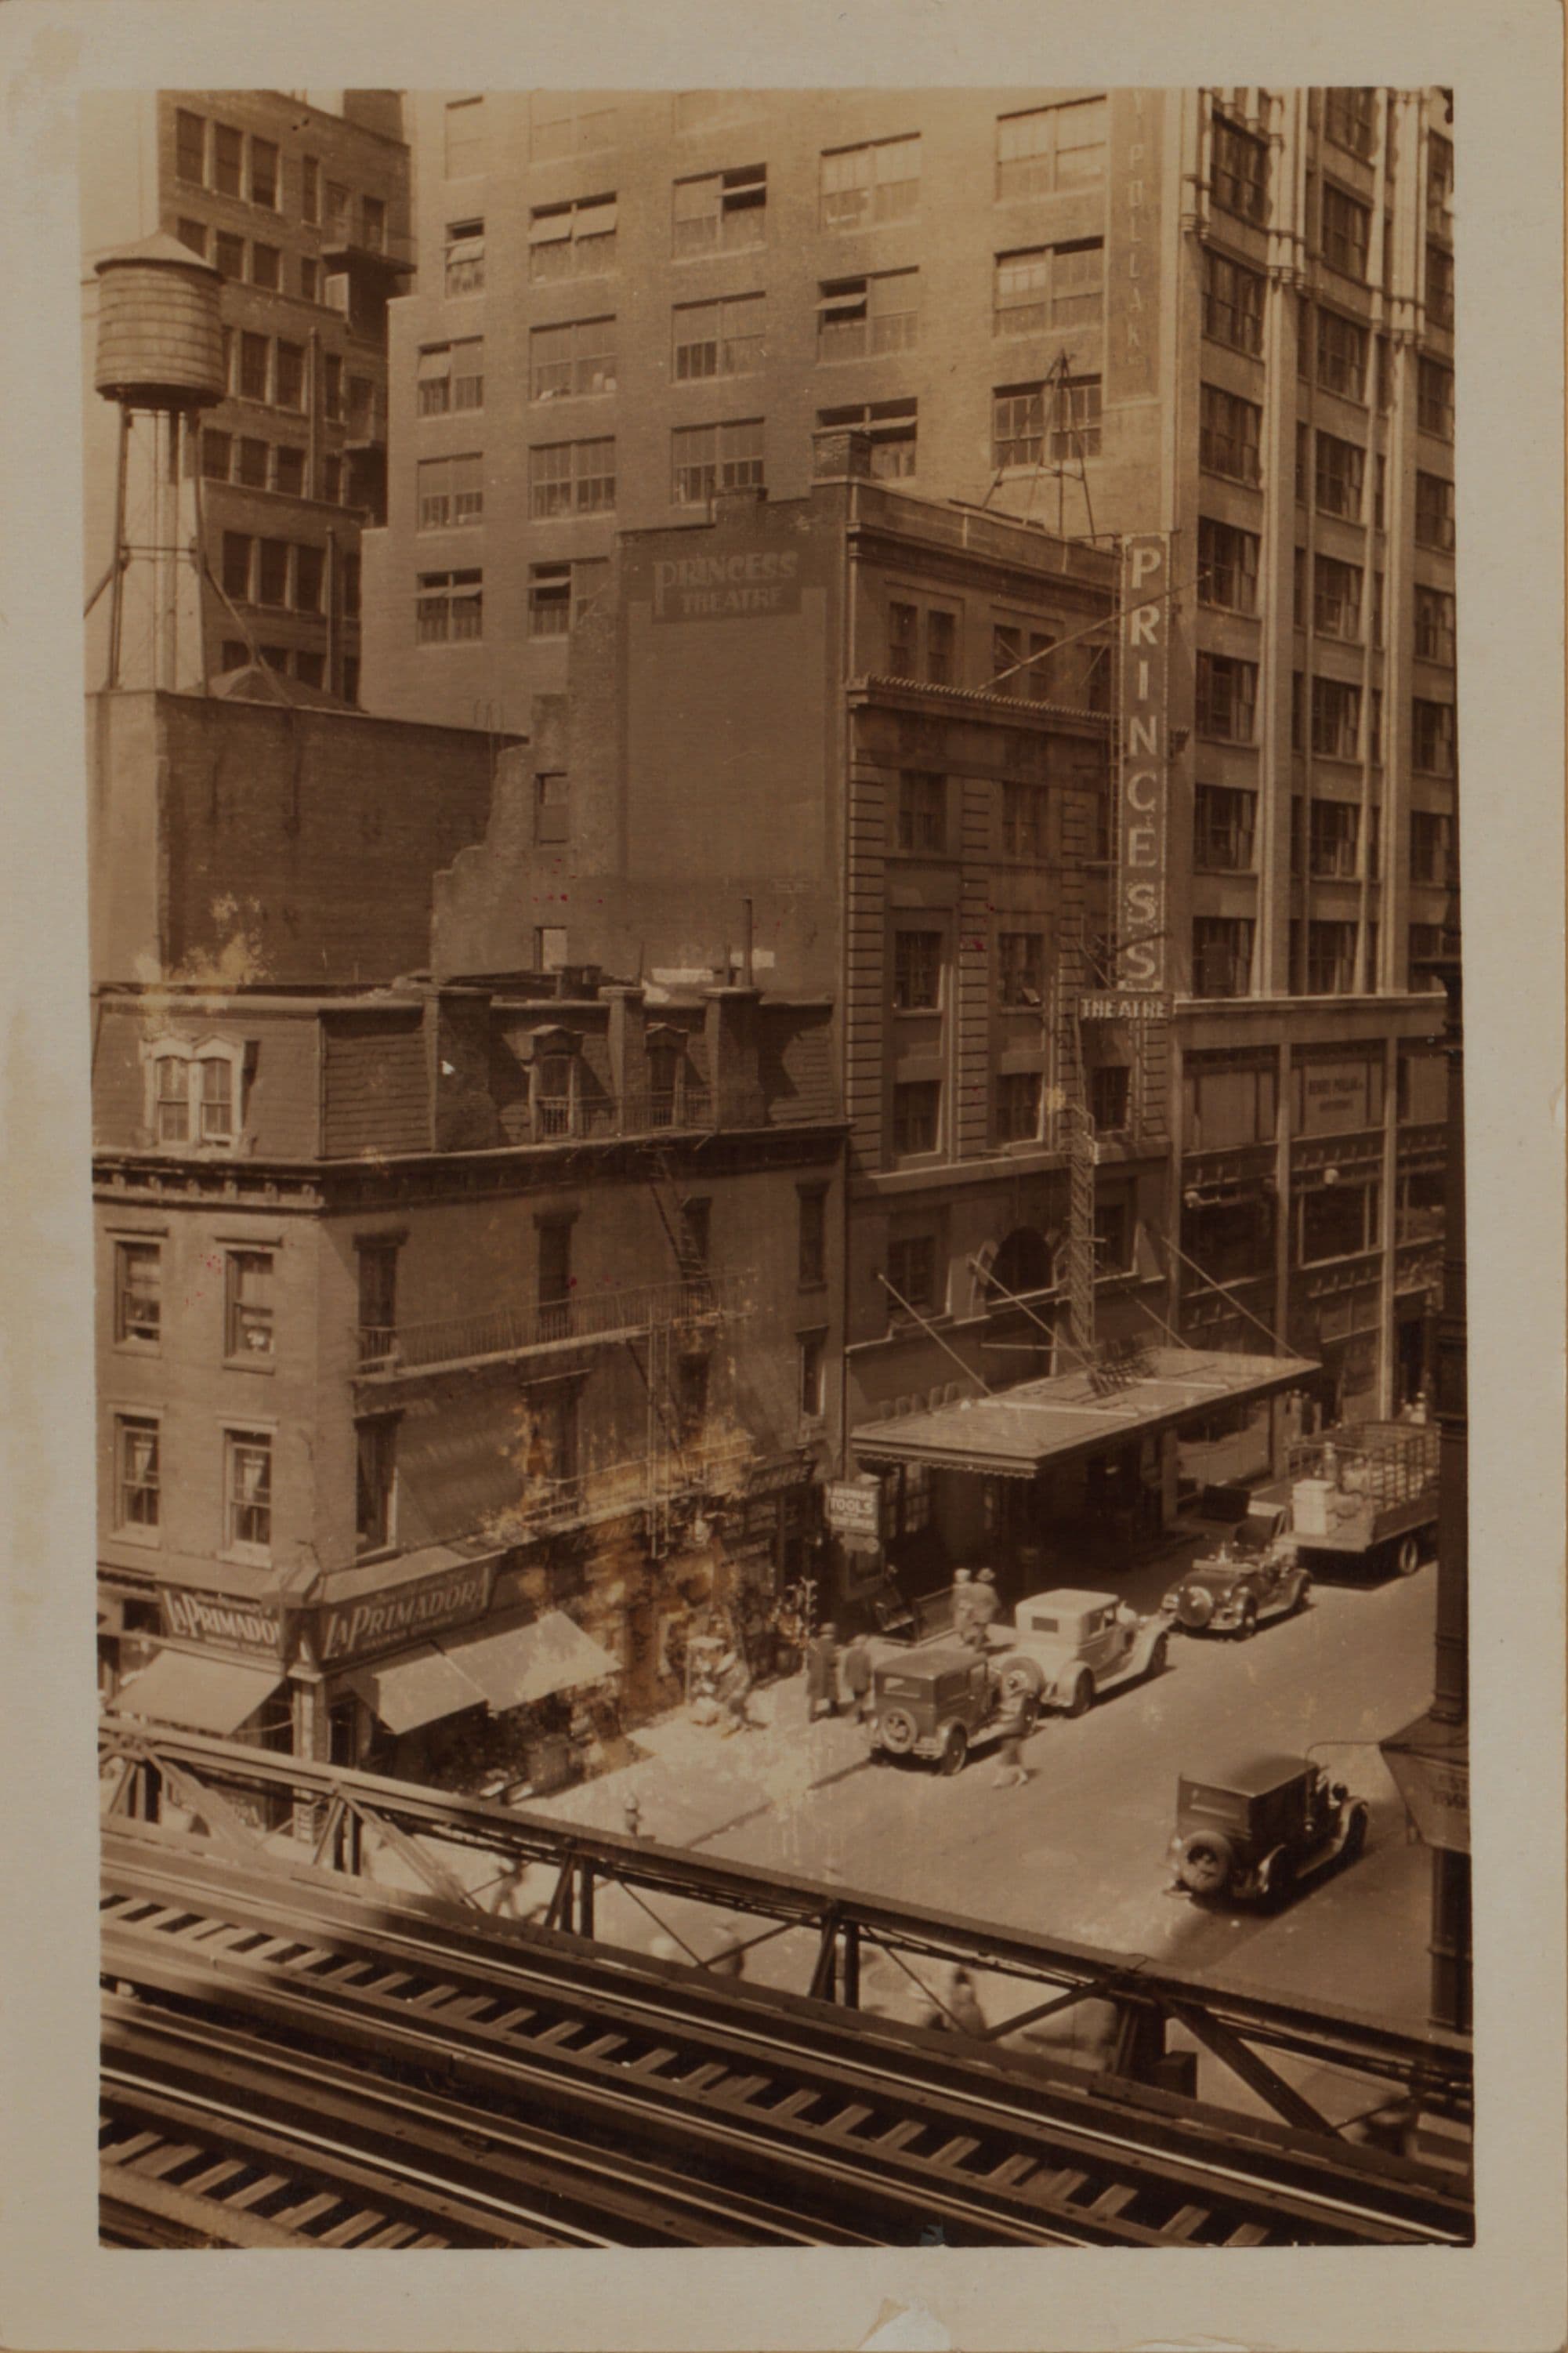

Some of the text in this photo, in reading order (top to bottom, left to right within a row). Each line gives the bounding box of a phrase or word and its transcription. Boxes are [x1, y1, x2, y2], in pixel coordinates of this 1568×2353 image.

[652, 551, 799, 615] PRINCESS
[679, 587, 784, 615] THEATRE
[1126, 548, 1161, 980] PRINCESS
[1080, 997, 1167, 1019] THEATRE
[828, 1496, 874, 1515] TOOLS
[346, 1568, 490, 1651] PRIMADORA
